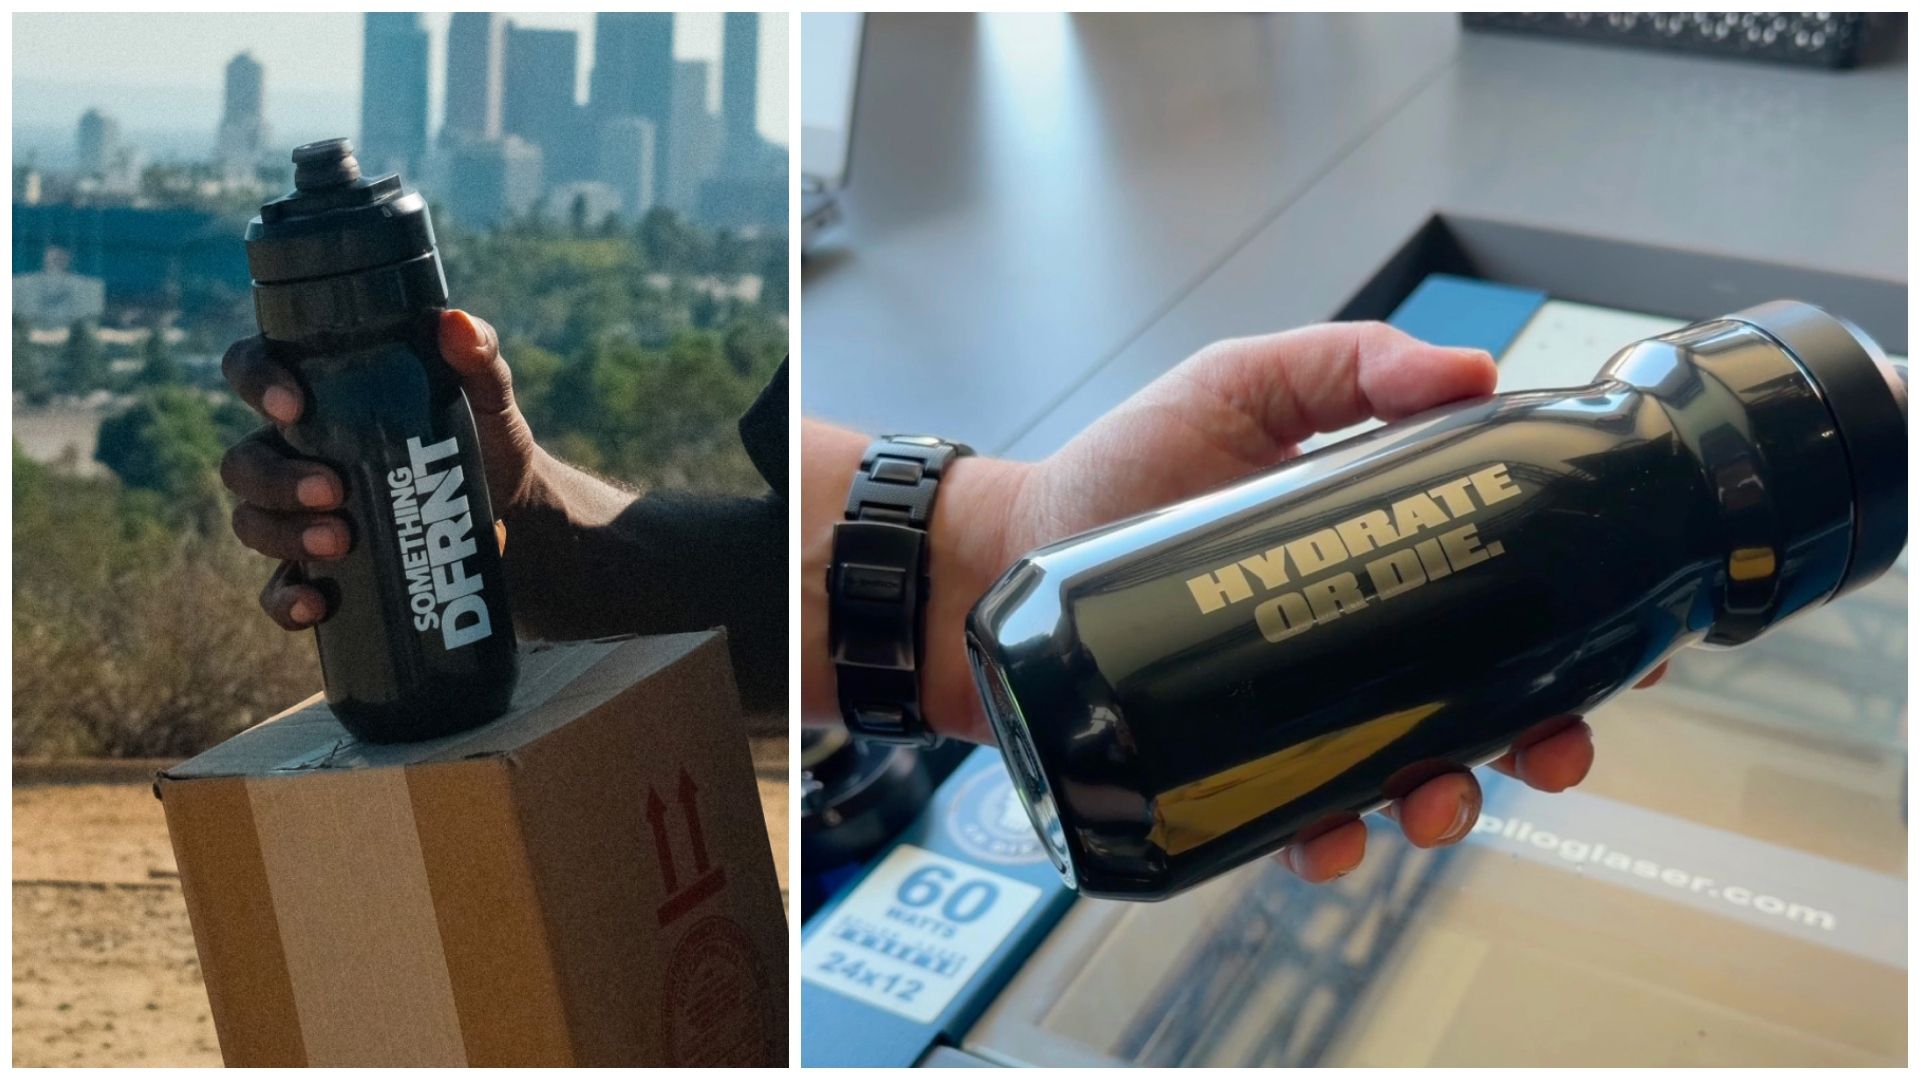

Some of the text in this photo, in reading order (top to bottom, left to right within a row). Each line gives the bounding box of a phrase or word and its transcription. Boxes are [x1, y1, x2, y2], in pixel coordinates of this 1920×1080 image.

[387, 466, 439, 632] SOMETHING
[406, 435, 492, 650] DFRNT
[1186, 463, 1522, 615] HYDRATE
[1254, 523, 1505, 643] OR DIE.
[885, 907, 956, 939] WATTS
[896, 864, 1000, 924] 60
[1473, 812, 1837, 932] piloglaser.com
